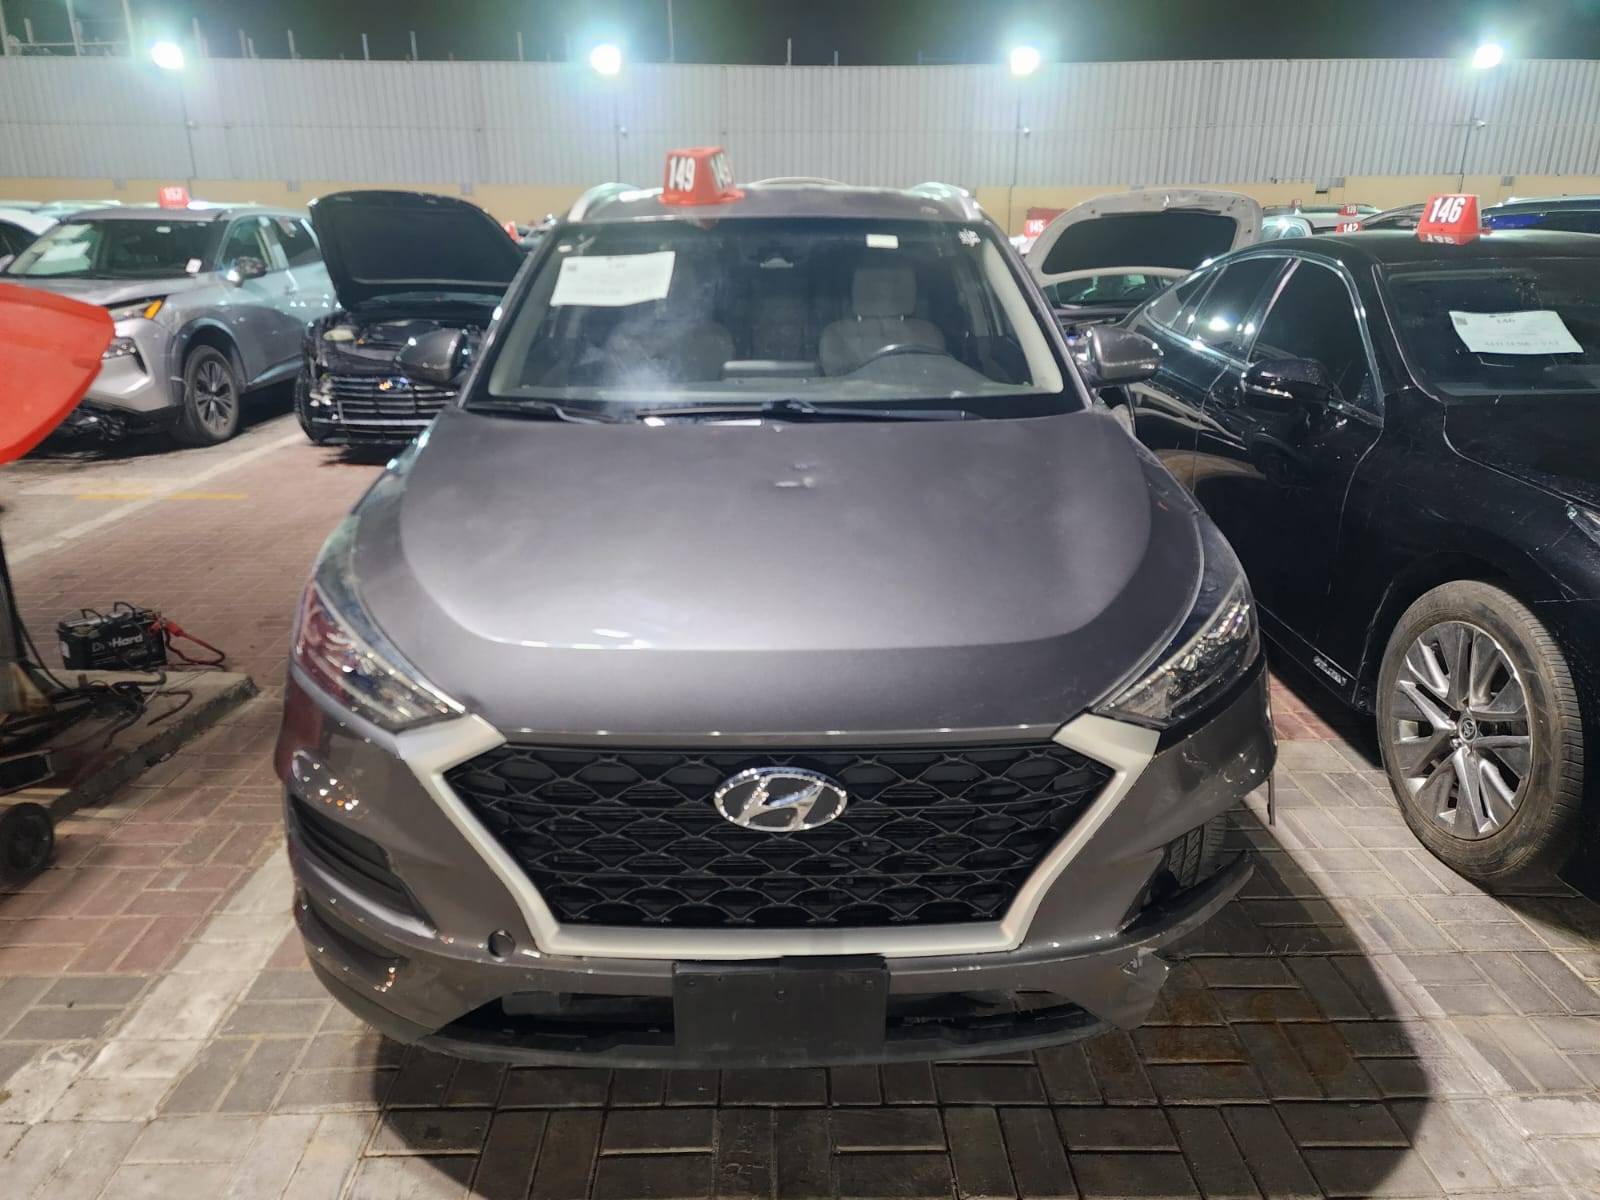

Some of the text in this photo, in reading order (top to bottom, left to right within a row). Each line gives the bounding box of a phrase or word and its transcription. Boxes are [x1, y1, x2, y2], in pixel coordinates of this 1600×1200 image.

[669, 155, 696, 192] 149
[1428, 197, 1466, 224] 146
[1343, 223, 1359, 233] 142
[92, 634, 143, 652] DiHard
